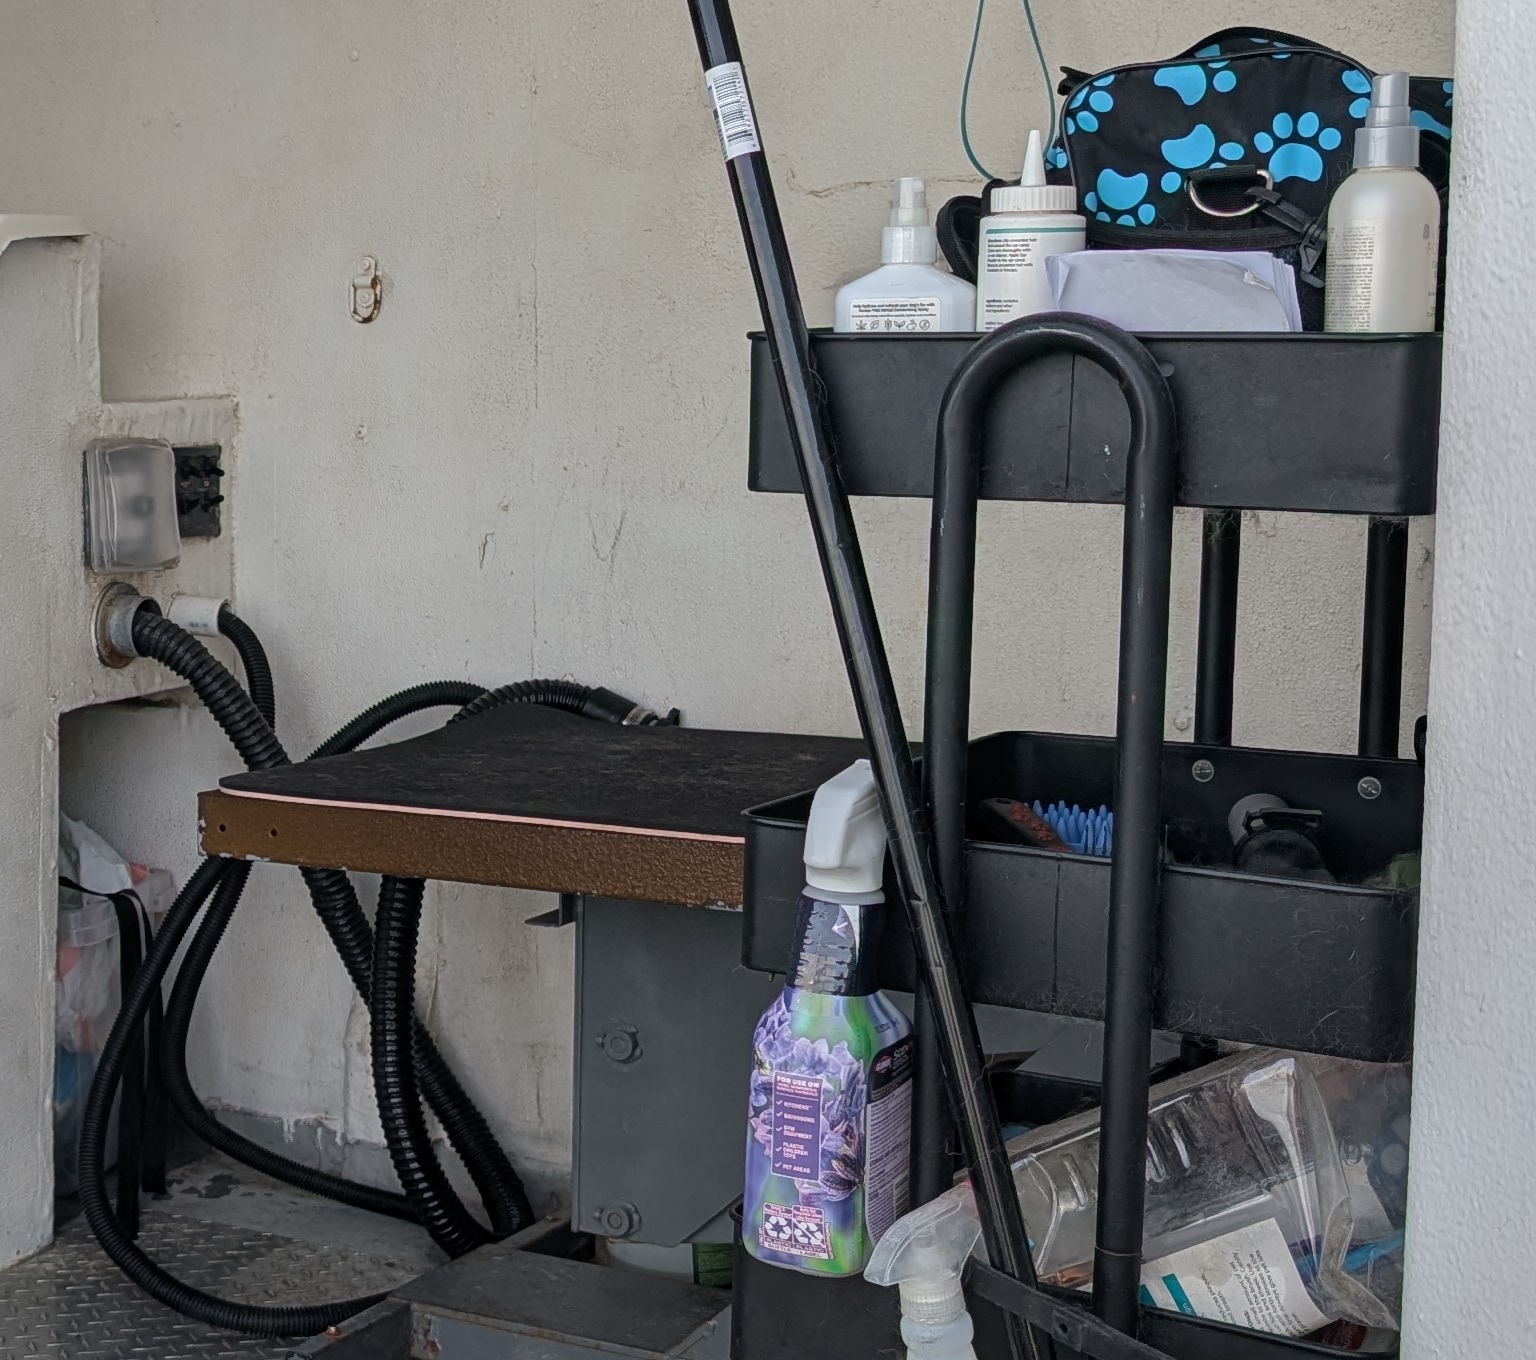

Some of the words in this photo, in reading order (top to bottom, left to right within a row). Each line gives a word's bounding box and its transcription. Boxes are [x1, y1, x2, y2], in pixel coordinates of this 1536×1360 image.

[777, 1075, 791, 1084] FOR
[792, 1078, 806, 1087] USE
[808, 1081, 819, 1089] ON
[793, 1165, 811, 1174] AREAS
[767, 1243, 792, 1252] BOTTLE
[1239, 1280, 1253, 1306] amount
[1272, 1289, 1285, 1312] Always
